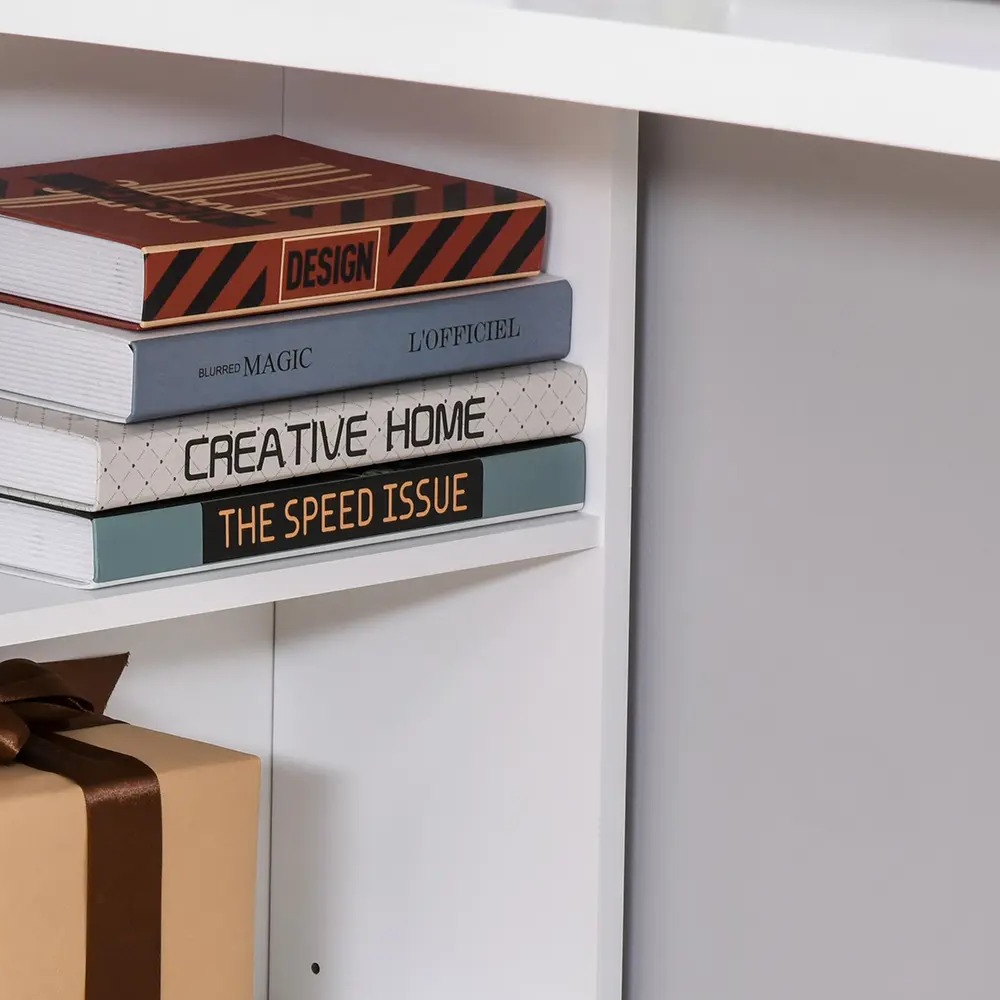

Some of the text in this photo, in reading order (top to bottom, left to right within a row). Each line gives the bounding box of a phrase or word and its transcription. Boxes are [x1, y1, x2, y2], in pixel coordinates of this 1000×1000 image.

[286, 241, 374, 290] DESIGN
[408, 317, 521, 353] L'OFFICIEL
[198, 347, 313, 378] BLURRED MAGIC
[184, 397, 485, 481] CREATIVE HOME
[218, 473, 469, 548] THE SPEED ISSUE
